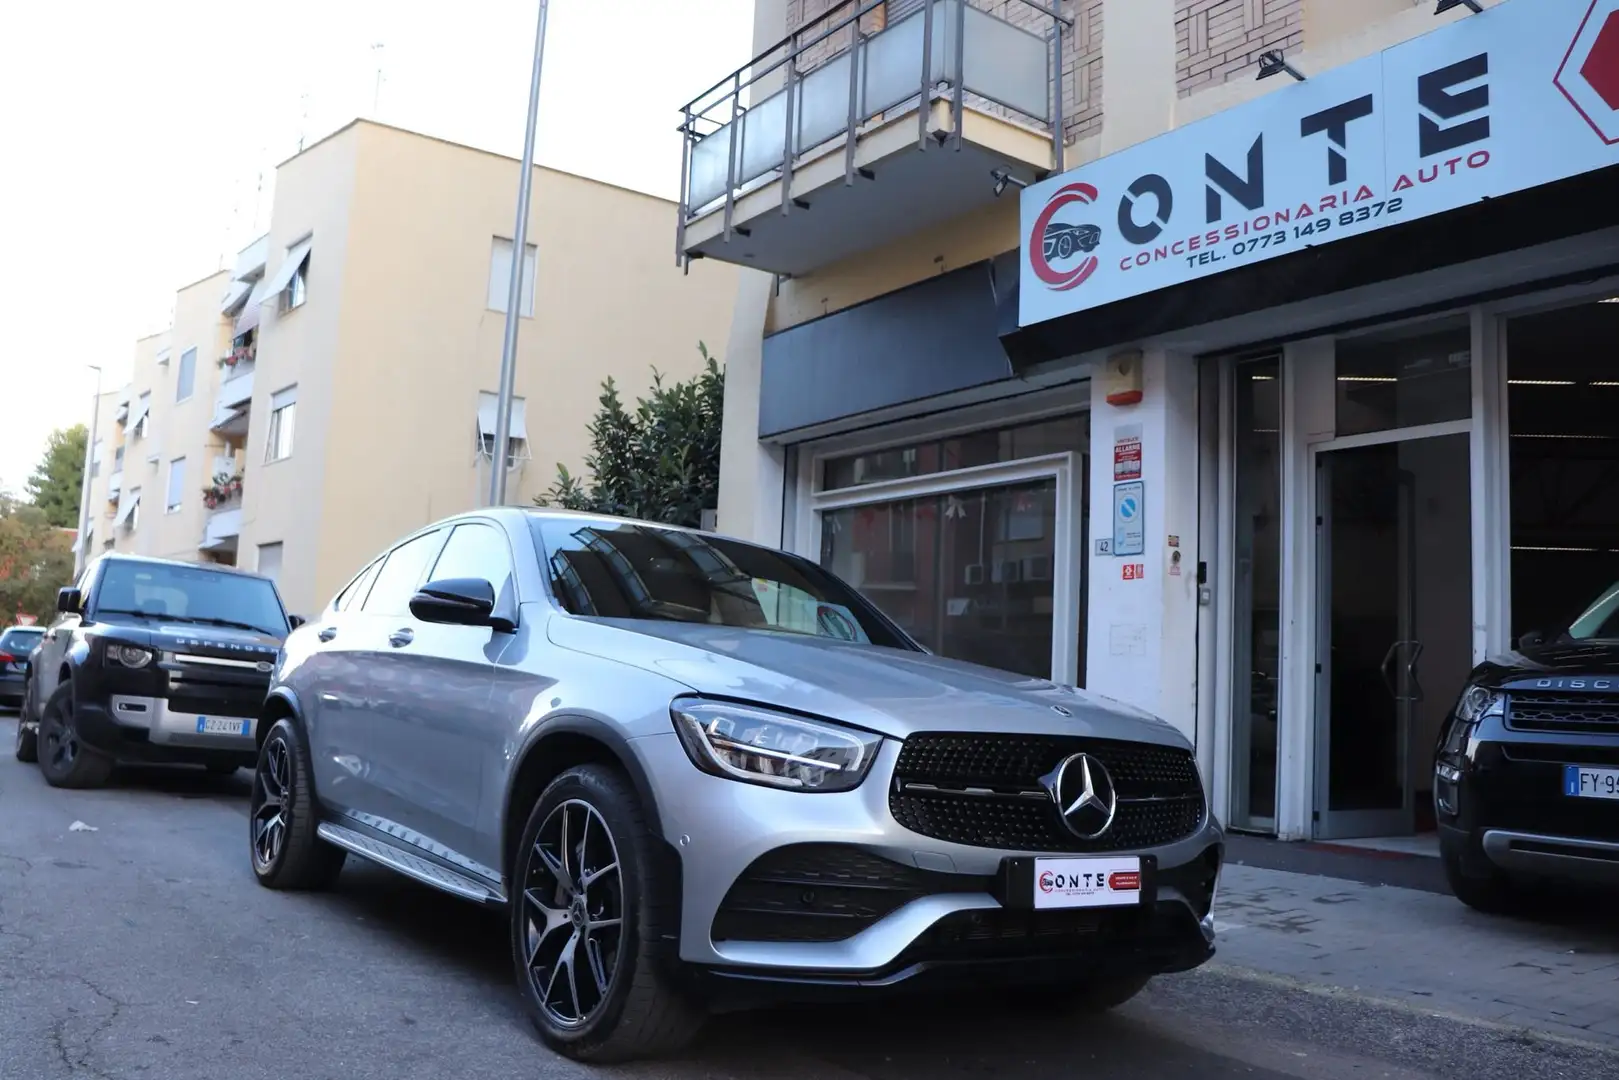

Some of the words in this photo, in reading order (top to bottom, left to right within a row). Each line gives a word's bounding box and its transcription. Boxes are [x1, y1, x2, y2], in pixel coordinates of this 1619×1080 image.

[1119, 185, 1375, 271] CONCESSIONARIA
[1392, 150, 1490, 192] AUTO
[1187, 250, 1226, 268] TEL.
[1232, 230, 1286, 256] 0773
[1293, 217, 1331, 239] 149
[1339, 197, 1403, 226] 8372
[176, 638, 279, 653] DEFENDER
[1536, 679, 1619, 689] DISC
